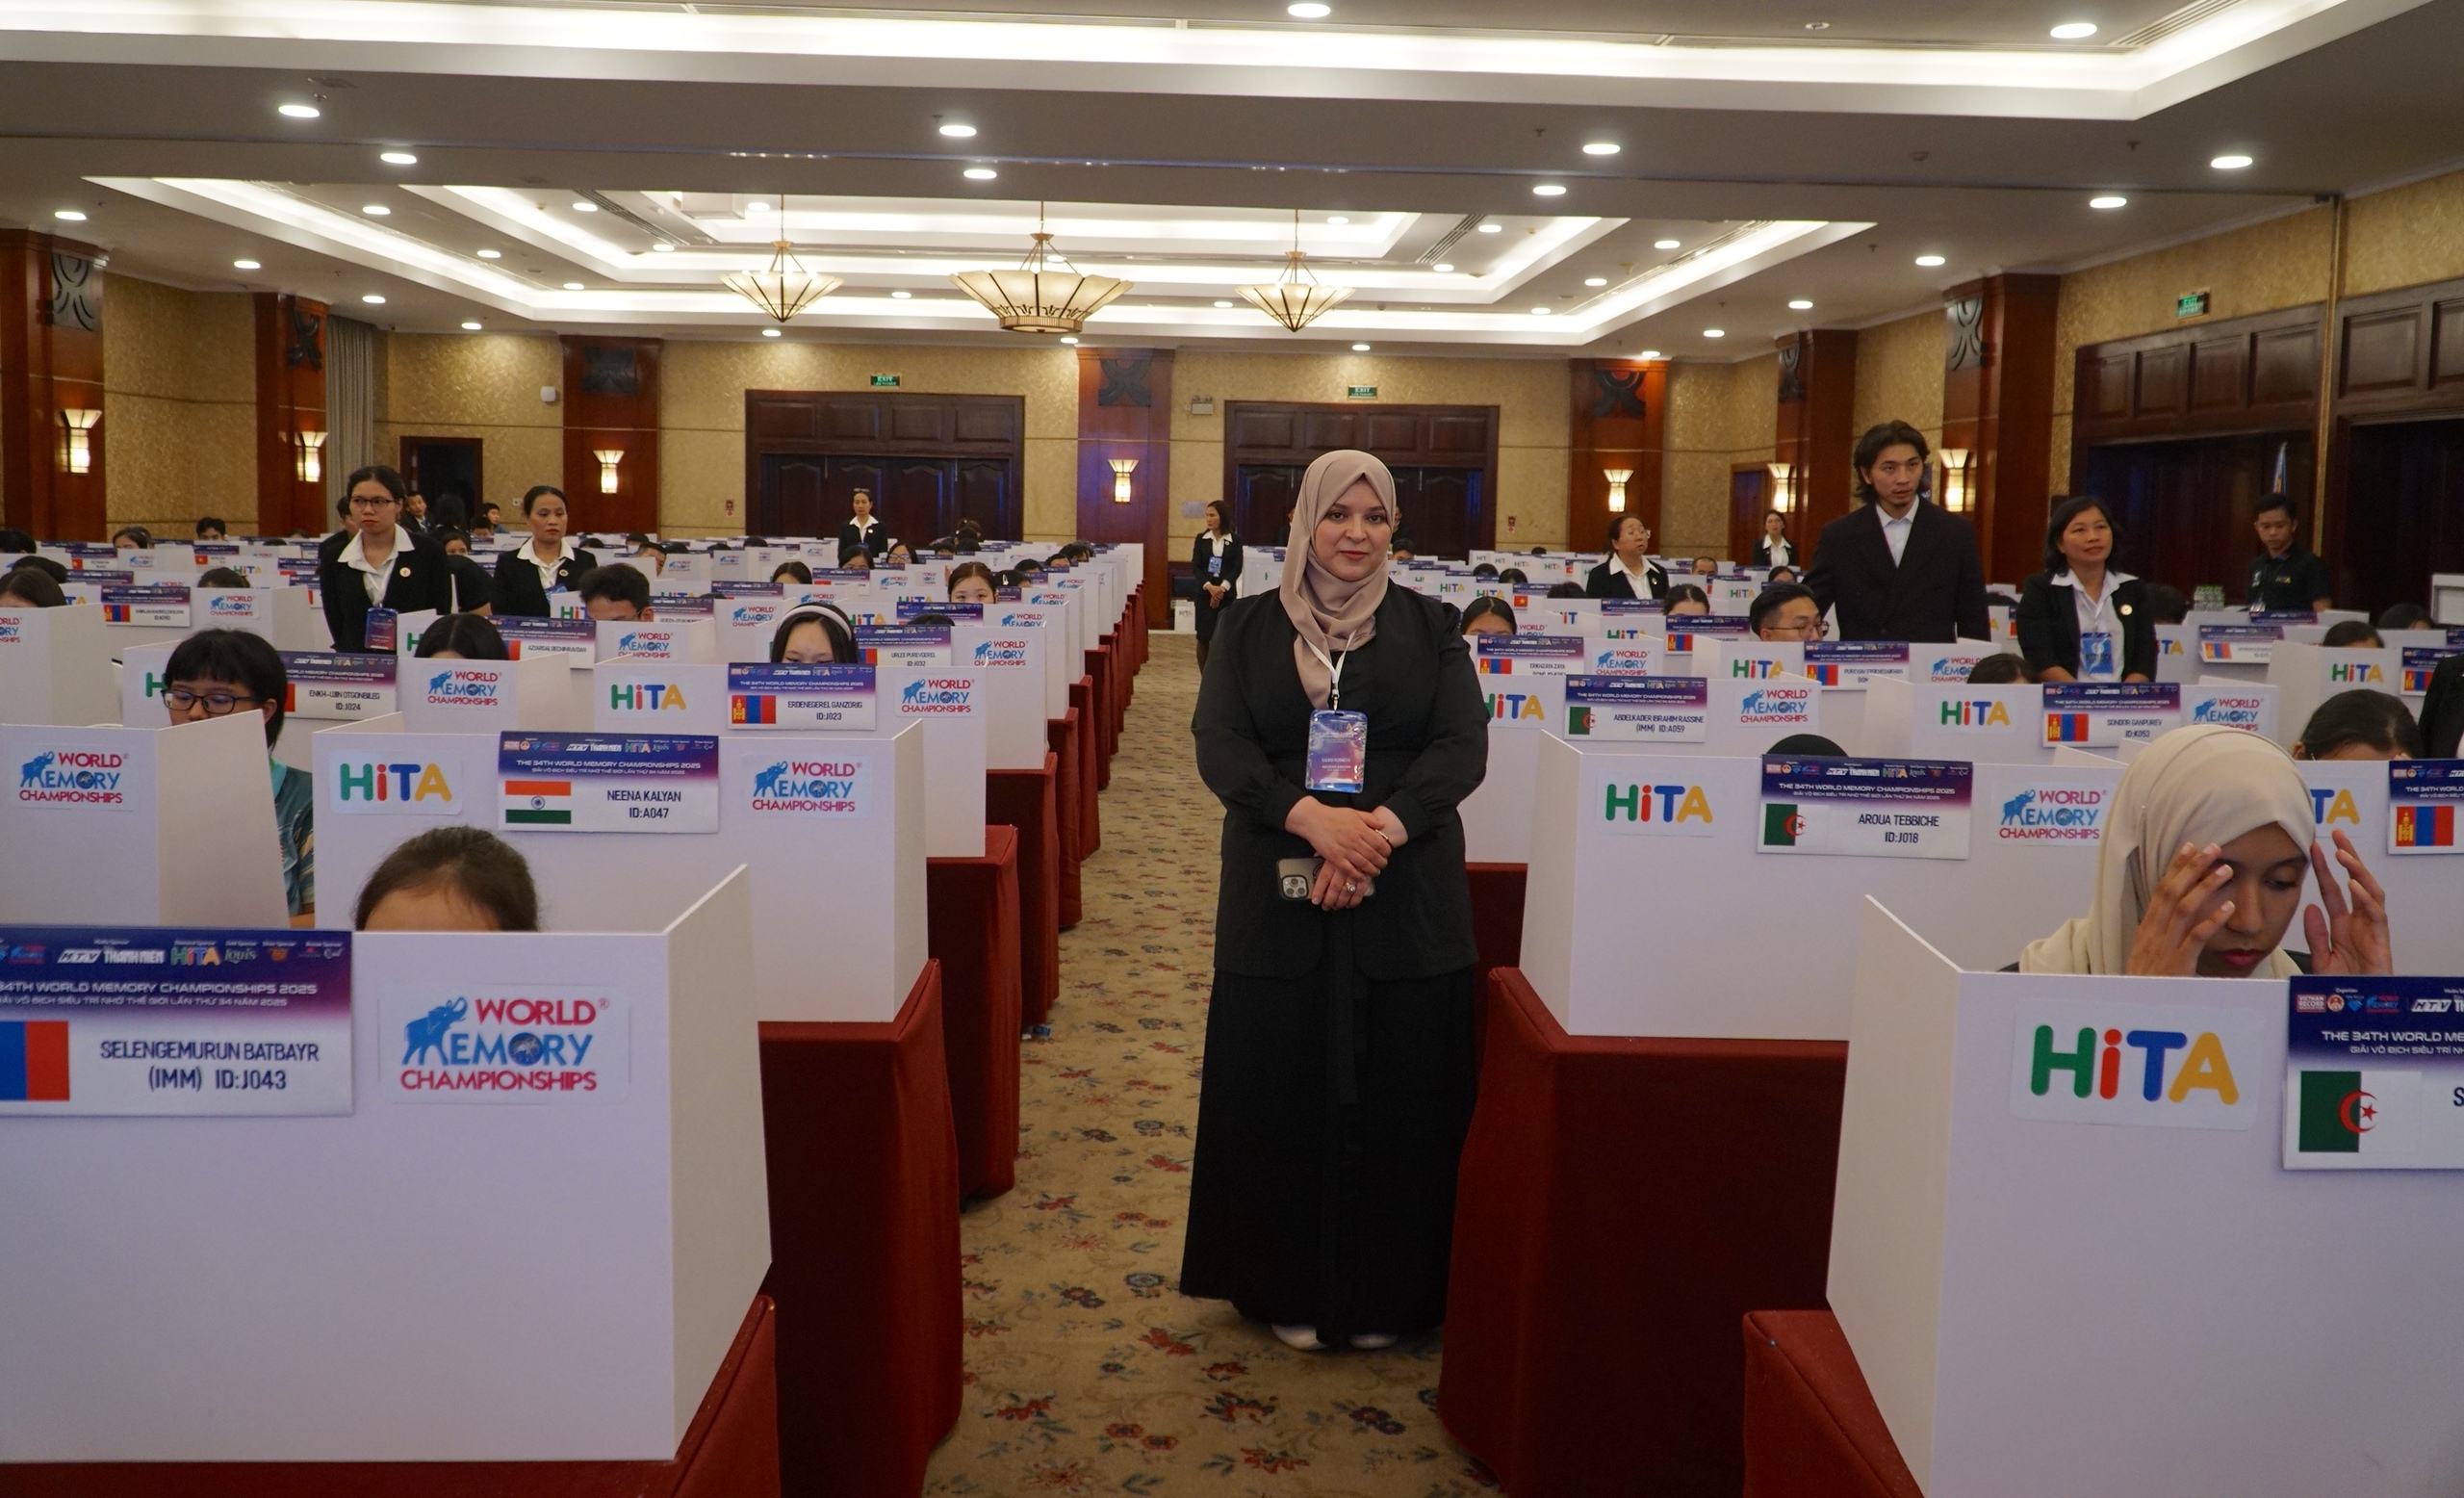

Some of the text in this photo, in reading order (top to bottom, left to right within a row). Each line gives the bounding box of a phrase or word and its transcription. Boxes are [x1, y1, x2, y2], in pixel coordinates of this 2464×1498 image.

[1616, 650, 1647, 659] WORLD
[455, 671, 498, 682] WORLD
[2331, 662, 2385, 684] HiTA
[928, 679, 971, 689] WORLD
[427, 696, 498, 706] CHAMPIONSHIPS
[611, 684, 686, 710] HiTA
[1767, 689, 1808, 700] WORLD
[901, 705, 971, 713] CHAMPIONSHIPS
[2219, 698, 2260, 709] WORLD
[816, 712, 842, 721] ID:J023
[1740, 714, 1808, 723] CHAMPIONSHIPS
[1941, 700, 2011, 725] HiTA
[1636, 724, 1685, 734] (IMM) ID:A059
[59, 752, 122, 768] WORLD
[792, 762, 856, 777] WORLD
[340, 762, 452, 802] HiTA
[19, 789, 123, 804] CHAMPIONSHIPS
[606, 789, 681, 803] NEENA KALYAN
[2039, 789, 2101, 805] WORLD
[752, 799, 856, 813] CHAMPIONSHIPS
[1605, 784, 1713, 824] HiTA
[629, 807, 669, 819] ID:A047
[1858, 814, 1939, 827] AROUA TEBBICHE
[1885, 831, 1919, 843] ID:J018
[1999, 827, 2100, 839] CHAMPIONSHIPS
[57, 948, 102, 963] HTV
[37, 982, 90, 994] WORLD
[91, 983, 158, 994] MEMORY
[160, 983, 276, 994] CHAMPIONSHIPS
[279, 984, 318, 995] 2025
[475, 998, 597, 1026] WORLD
[2411, 999, 2452, 1012] HTV
[2322, 1030, 2349, 1042] THE
[2352, 1031, 2389, 1042] 34TH
[2392, 1031, 2442, 1043] WORLD
[100, 1040, 320, 1062] SELENGEMURUN BATBAYR
[2031, 1024, 2240, 1106] HiTA
[149, 1065, 287, 1092] (IMM) ID:J043
[400, 1069, 598, 1092] CHAMPIONSHIPS
